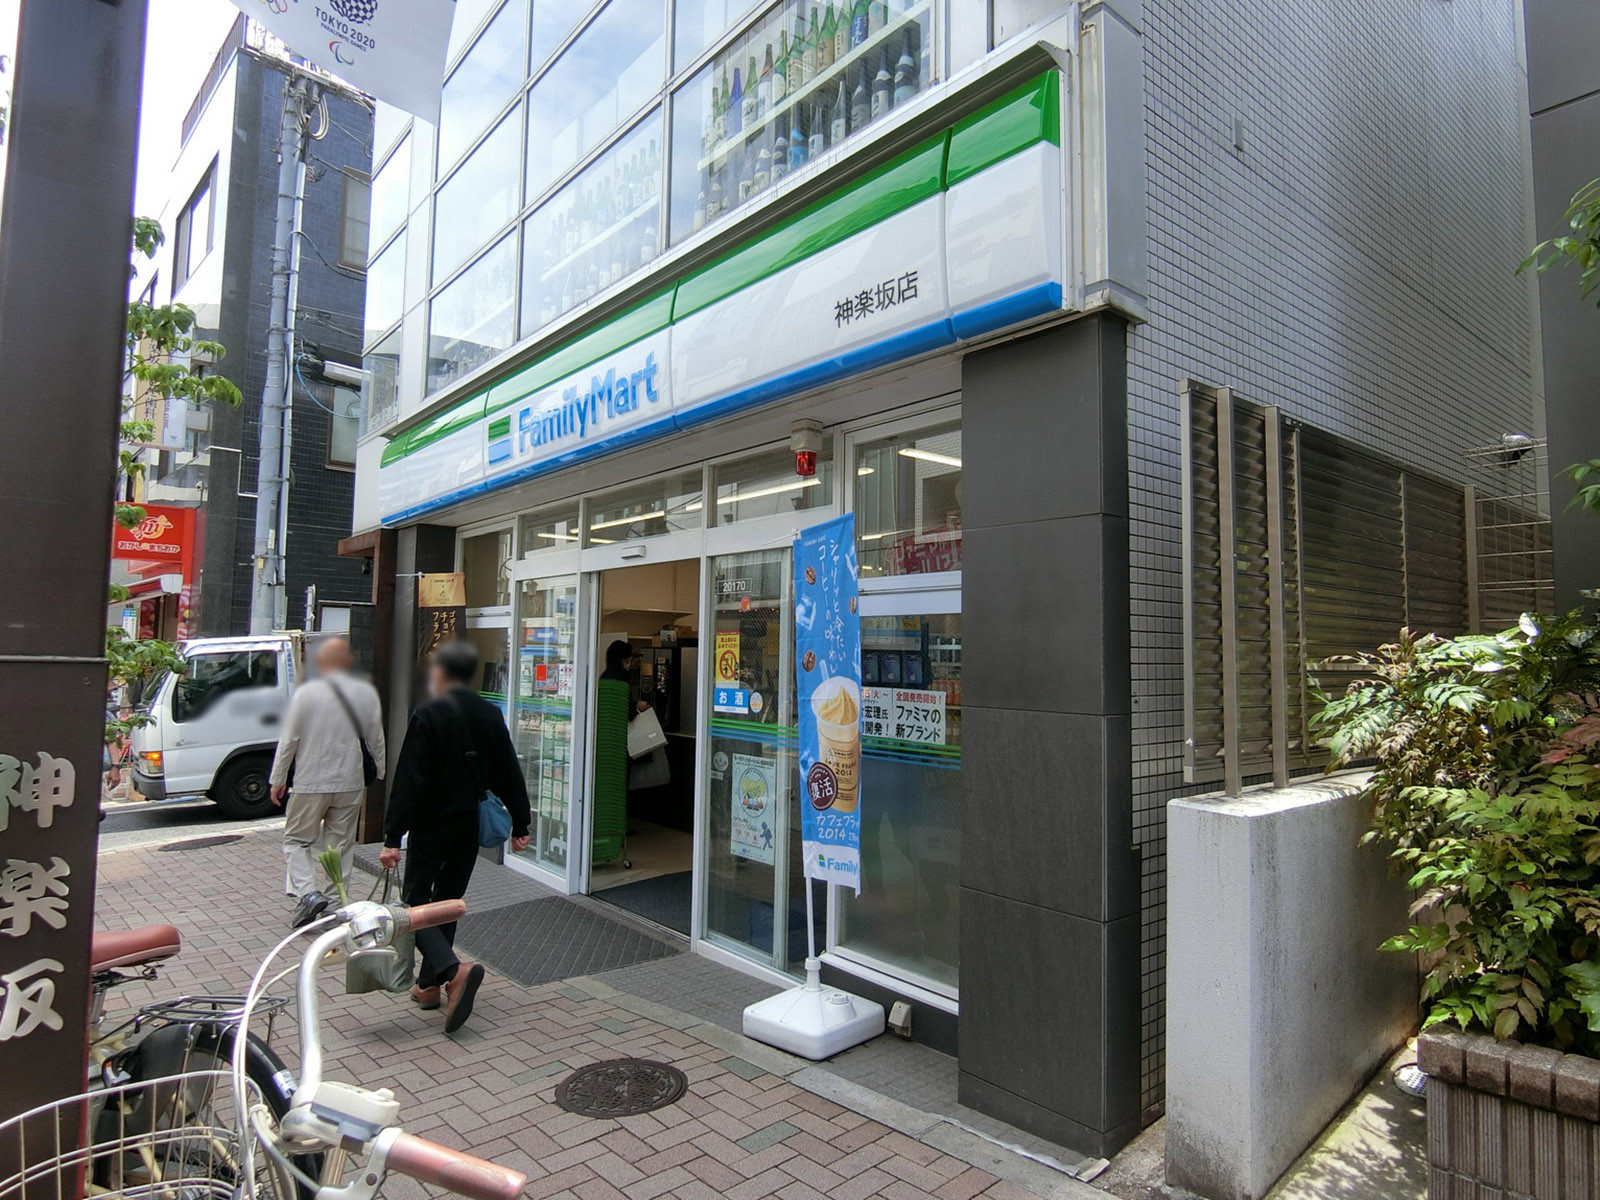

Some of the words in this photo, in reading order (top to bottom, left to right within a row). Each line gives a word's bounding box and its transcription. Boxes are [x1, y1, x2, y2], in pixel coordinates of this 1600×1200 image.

[314, 6, 349, 34] TOKYO
[350, 28, 376, 49] 2020
[834, 270, 919, 328] 神楽坂店
[519, 352, 659, 453] FamilyMart
[722, 581, 746, 592] 20170
[830, 539, 847, 662] シャリッと冷たい
[718, 690, 744, 706] お酒
[862, 705, 889, 720] 宏理氏
[895, 705, 942, 724] ファミマの
[862, 721, 889, 736] 開発！
[895, 723, 942, 742] 新ブランド
[811, 776, 833, 801] 復活
[816, 812, 858, 829] カフェフラ
[818, 827, 846, 841] 2014
[827, 857, 858, 875] Family
